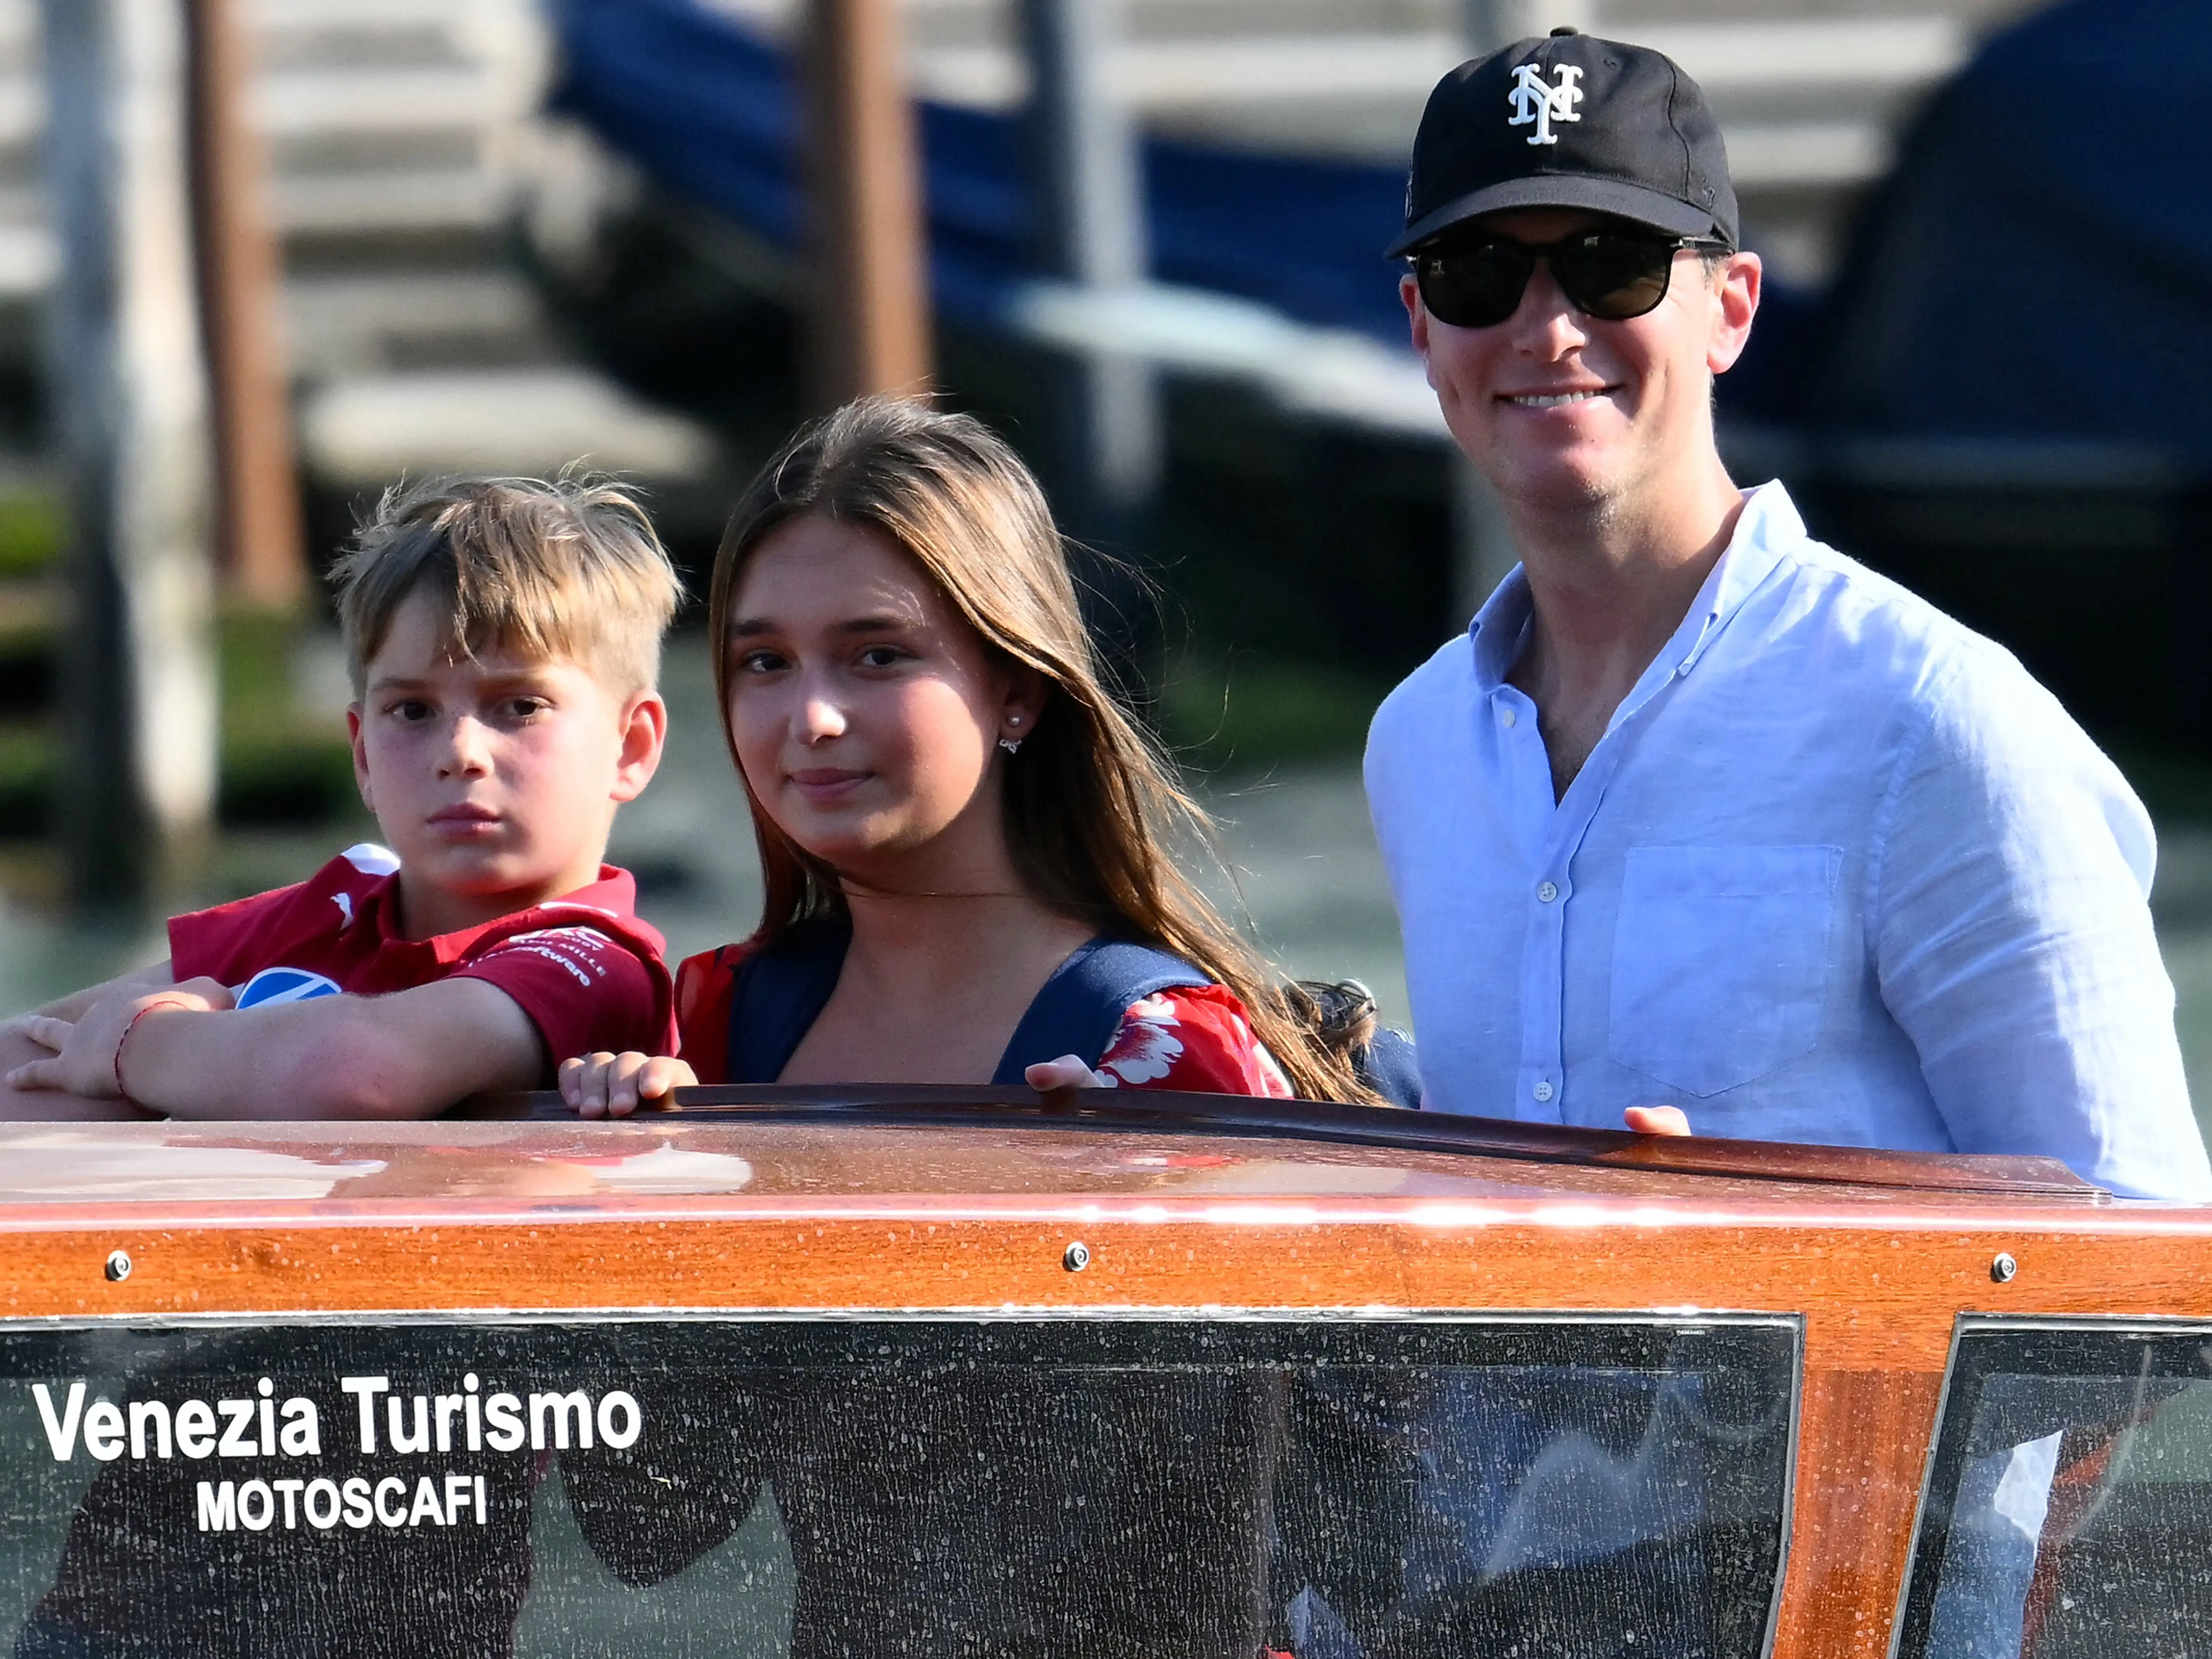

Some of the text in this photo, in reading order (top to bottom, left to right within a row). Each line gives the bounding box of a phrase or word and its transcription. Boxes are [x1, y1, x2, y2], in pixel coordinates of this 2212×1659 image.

[32, 1372, 642, 1461] Venezia Turismo
[197, 1475, 486, 1532] MOTOSCAFI
